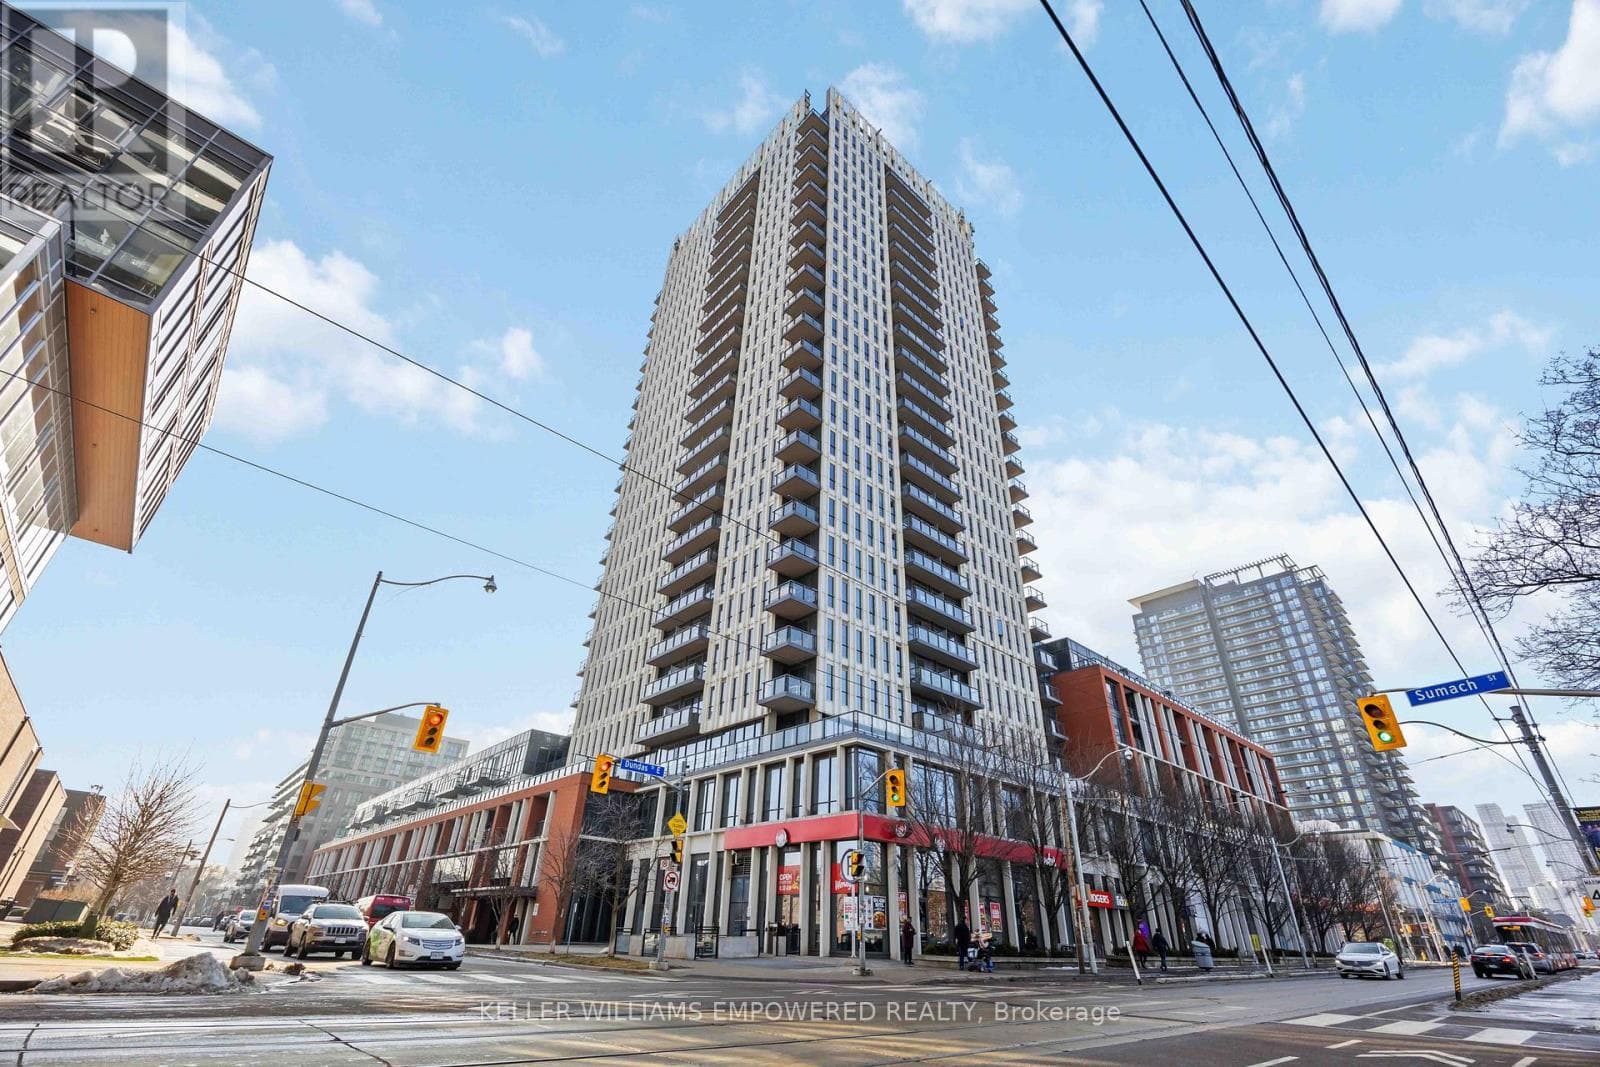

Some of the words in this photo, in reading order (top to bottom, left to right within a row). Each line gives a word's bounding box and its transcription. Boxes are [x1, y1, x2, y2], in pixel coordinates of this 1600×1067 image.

[1415, 680, 1478, 701] Sumach
[1487, 674, 1497, 682] St
[625, 760, 648, 772] Dundas
[656, 767, 661, 775] E
